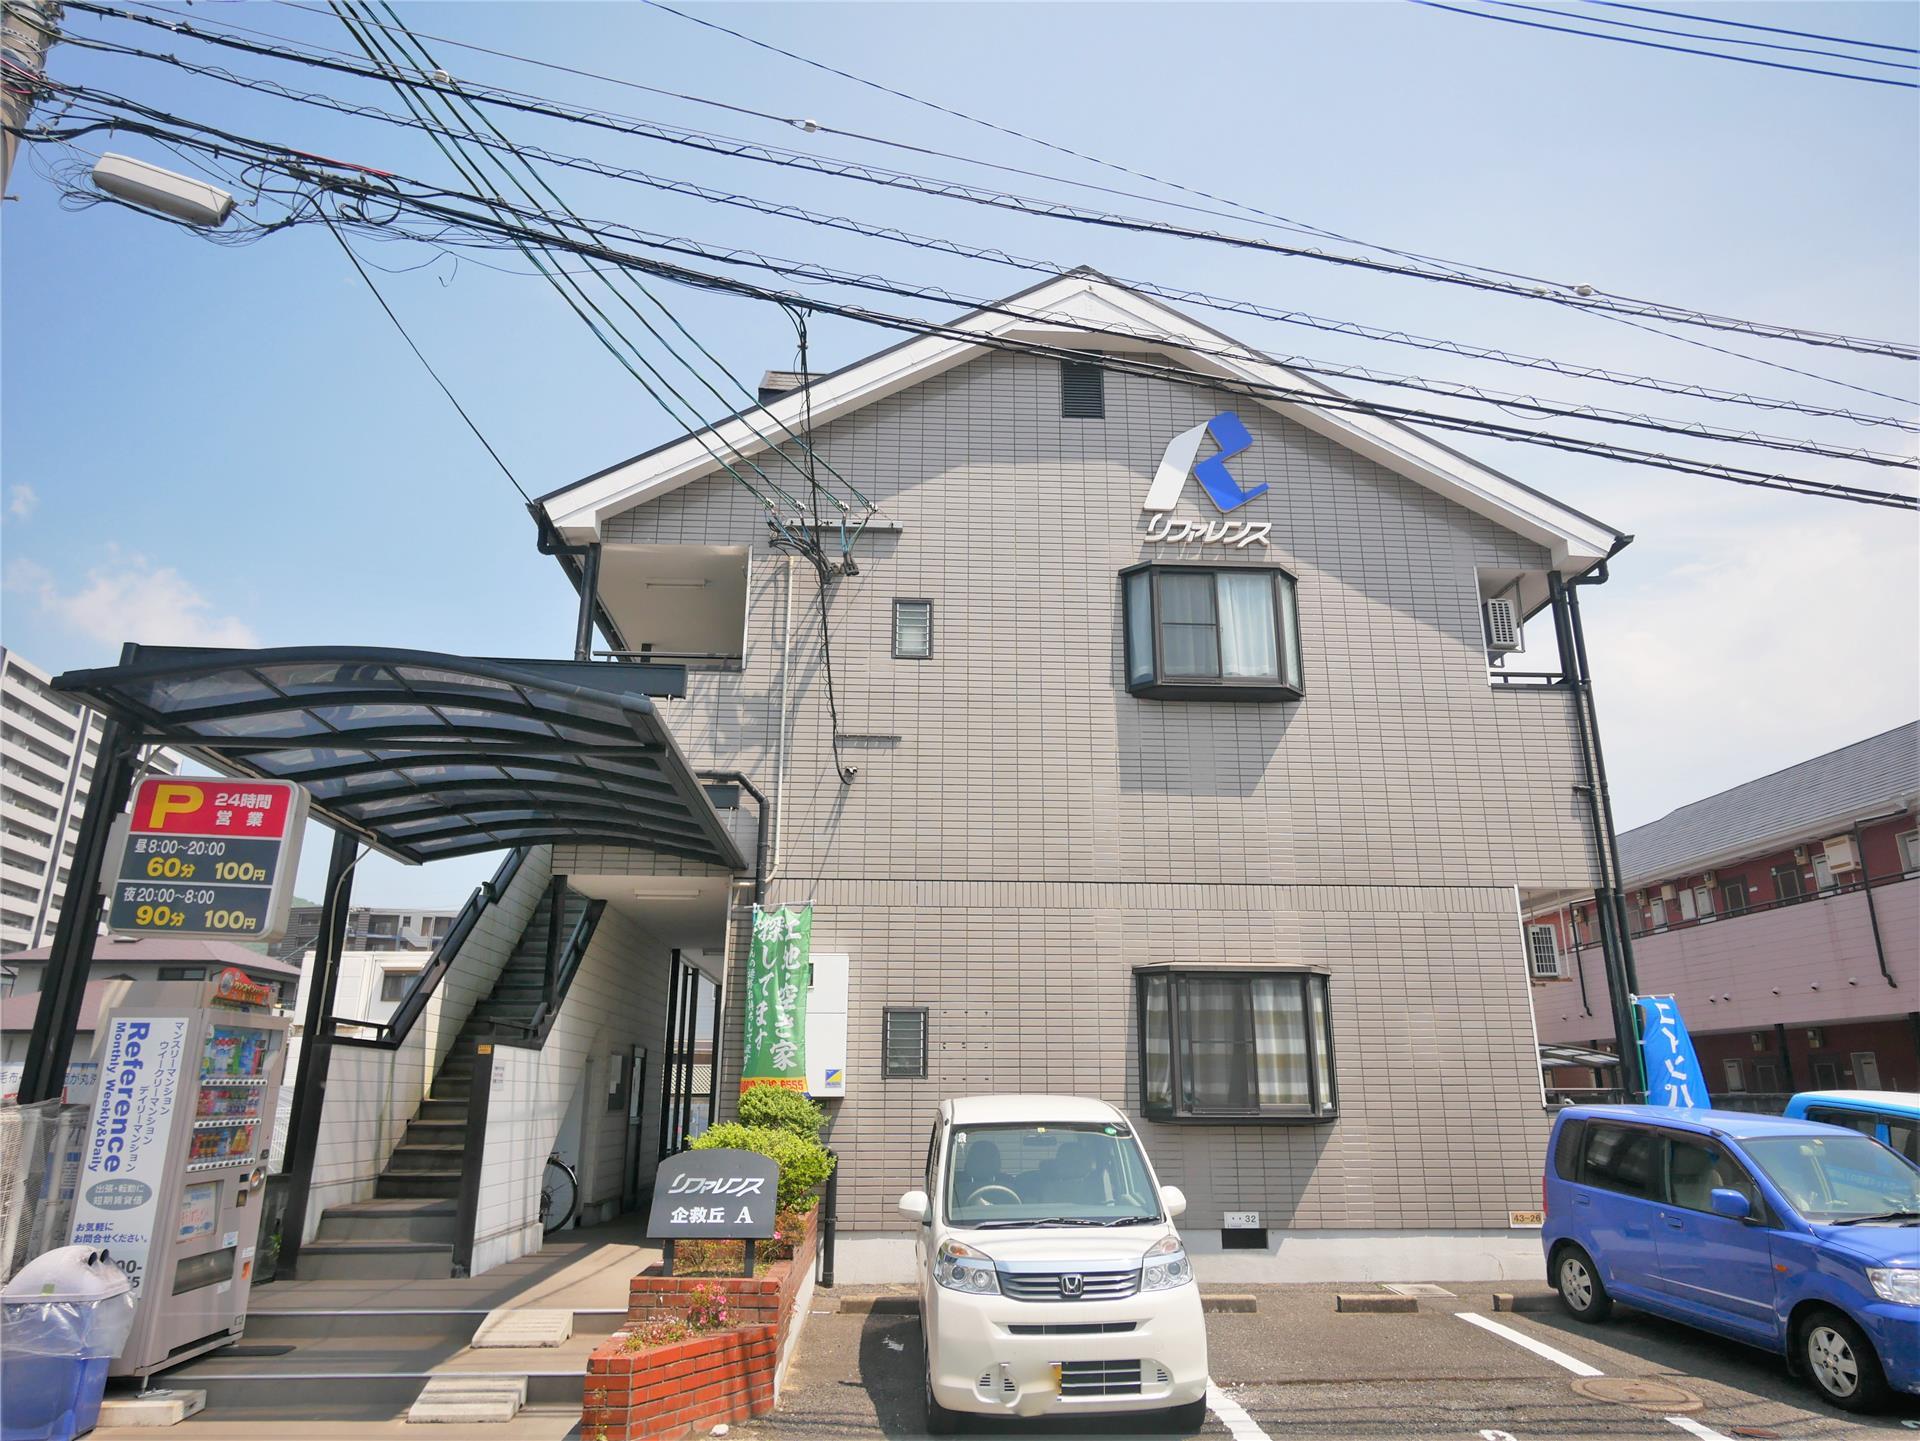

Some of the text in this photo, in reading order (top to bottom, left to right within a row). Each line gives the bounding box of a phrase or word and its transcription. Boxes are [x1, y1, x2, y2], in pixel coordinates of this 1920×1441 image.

[1143, 513, 1272, 548] リファレンス
[148, 784, 204, 828] P
[214, 792, 273, 810] 24時間
[146, 856, 266, 881] 60分 100円
[135, 905, 257, 929] 90分 100円
[754, 915, 785, 1056] 探してます
[104, 1022, 150, 1173] Reference
[87, 1079, 117, 1172] Weekly&Daily
[667, 1173, 765, 1197] リファレンス
[75, 1222, 114, 1232] お気軽に
[670, 1206, 754, 1224] 企救丘 A
